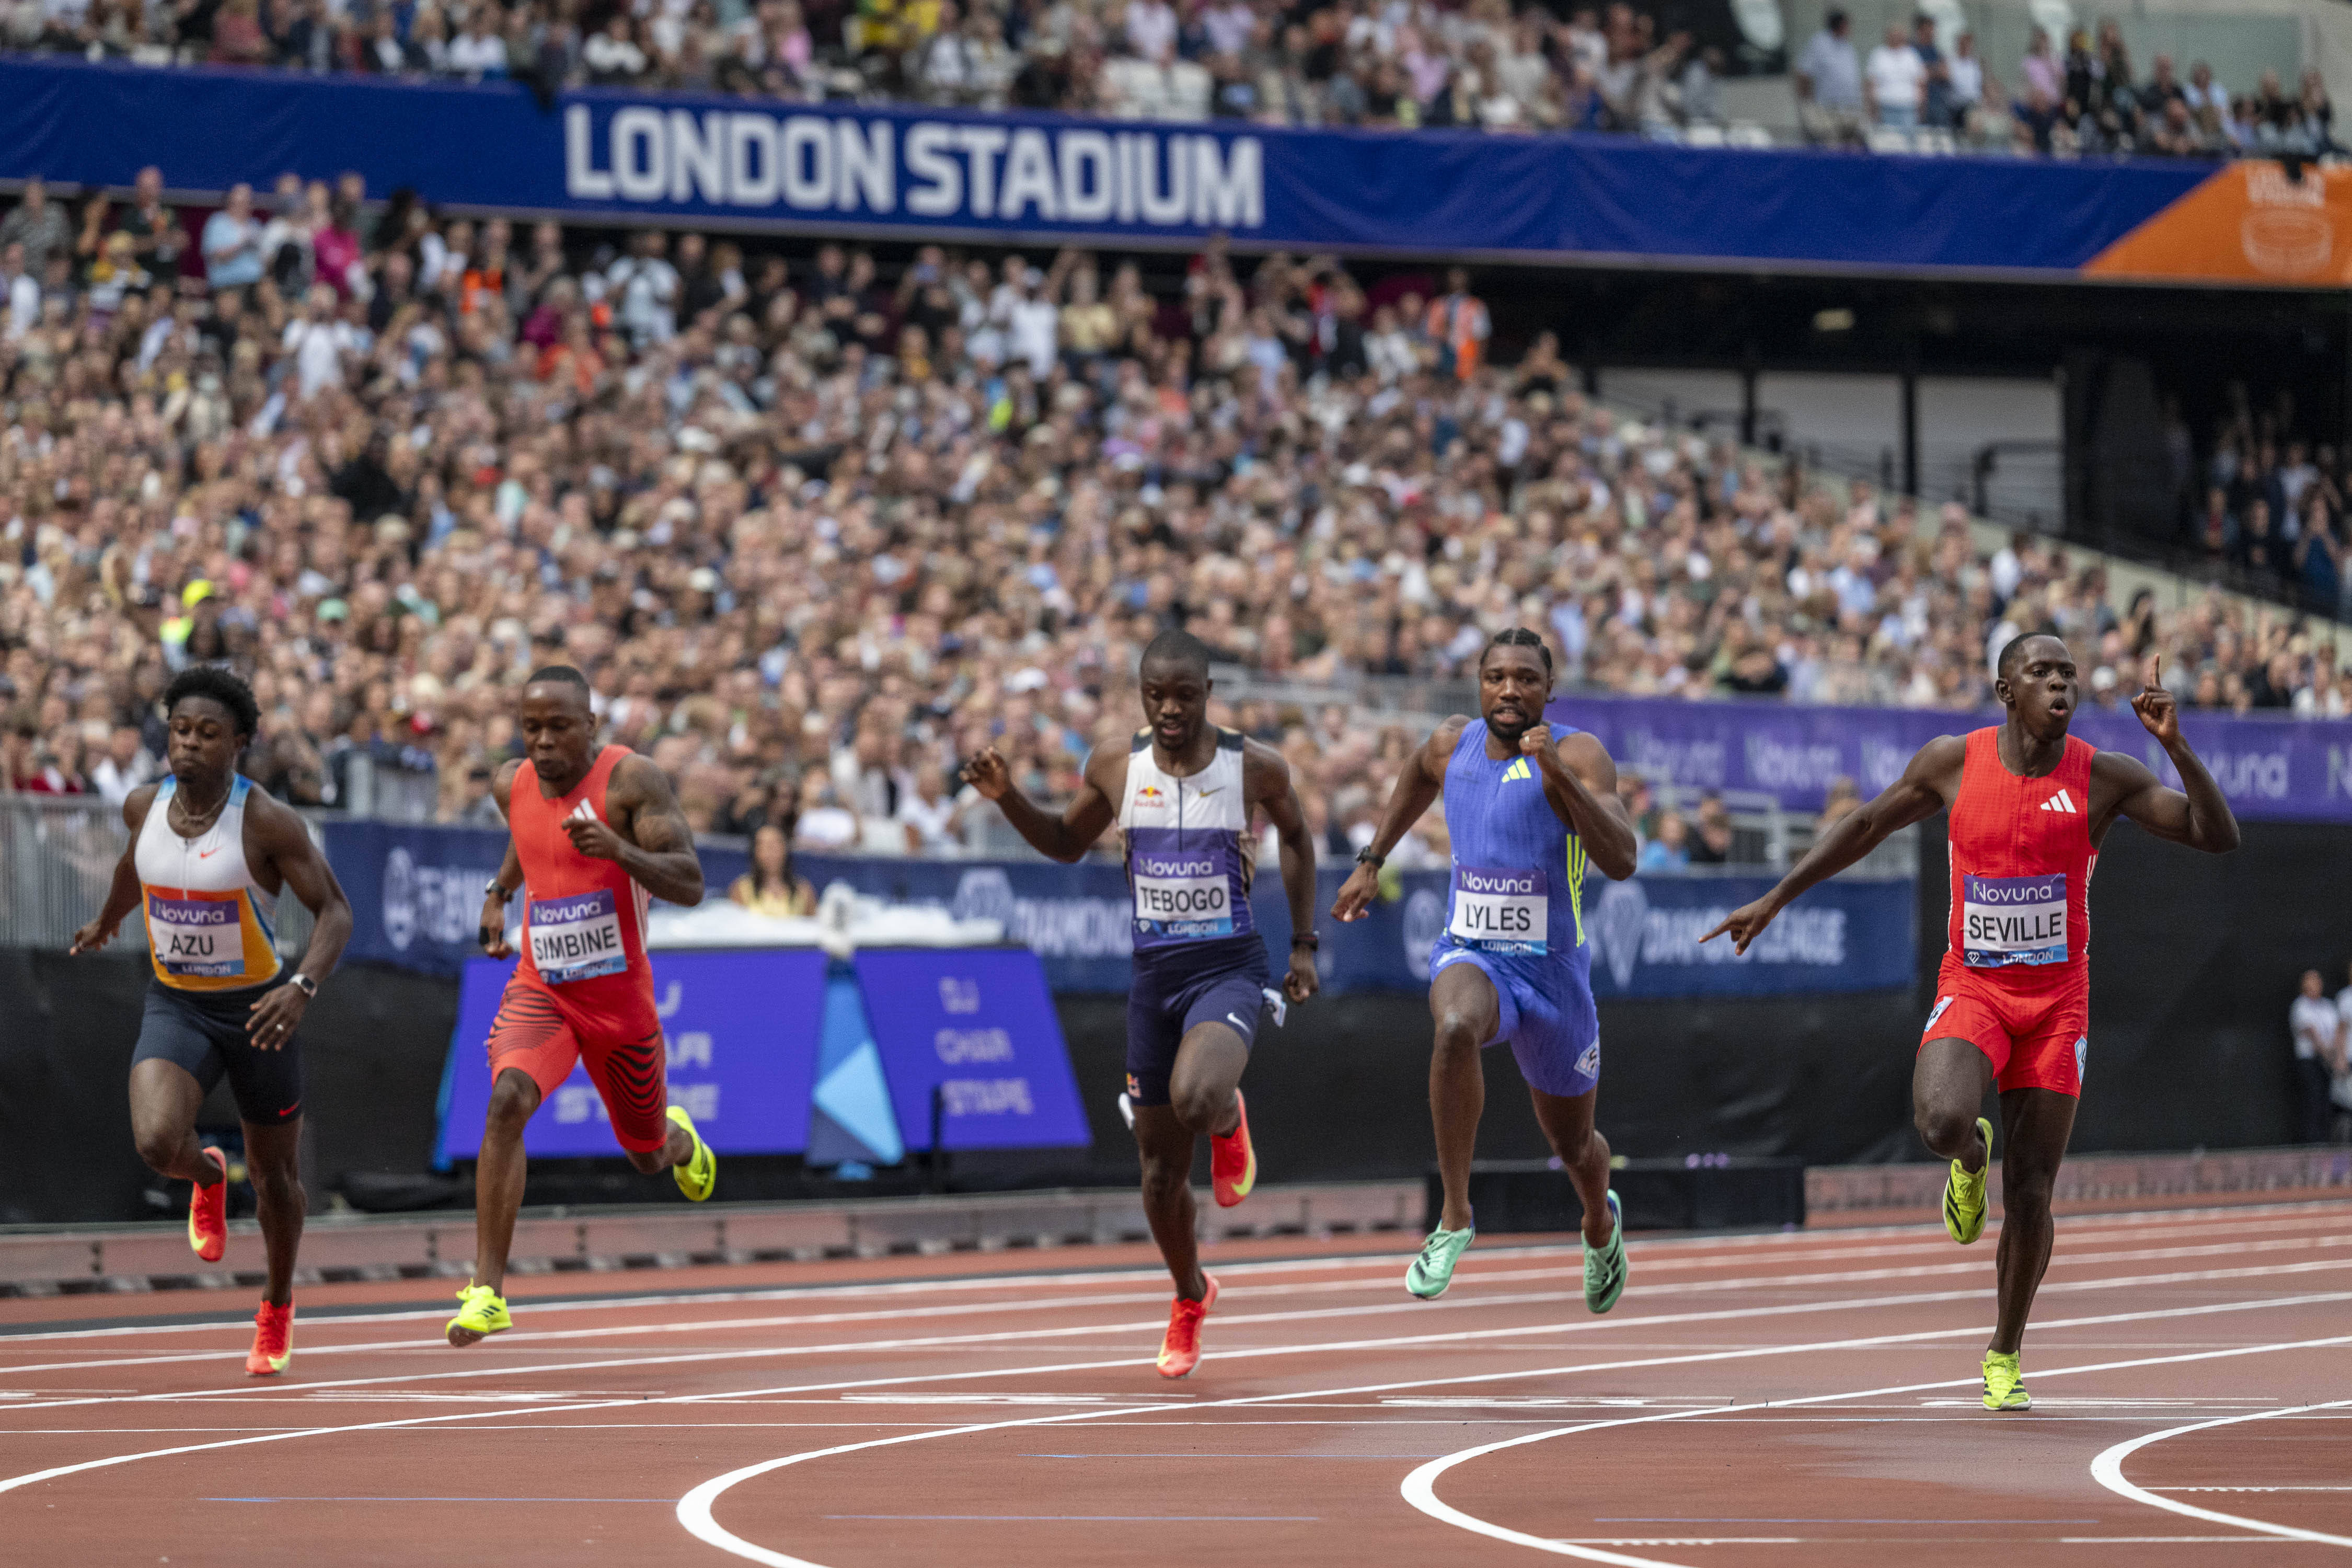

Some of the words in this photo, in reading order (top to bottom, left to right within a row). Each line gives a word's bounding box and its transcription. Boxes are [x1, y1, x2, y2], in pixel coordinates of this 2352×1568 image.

[566, 105, 896, 215] LONDON
[905, 122, 1265, 229] STADIUM
[1139, 858, 1213, 876] Novuna
[1462, 871, 1532, 893] Novuna
[1973, 881, 2053, 902] Novuna
[1140, 887, 1224, 913] TEBOGO
[157, 902, 225, 924] Novuna
[534, 901, 601, 924] Novuna
[1466, 903, 1531, 931] LYLES
[1167, 922, 1218, 935] LONDON
[1968, 912, 2062, 942] SEVILLE
[170, 934, 214, 956] AZU
[533, 925, 617, 961] SIMBINE
[1481, 940, 1532, 953] LONDON
[2002, 950, 2054, 964] LONDON
